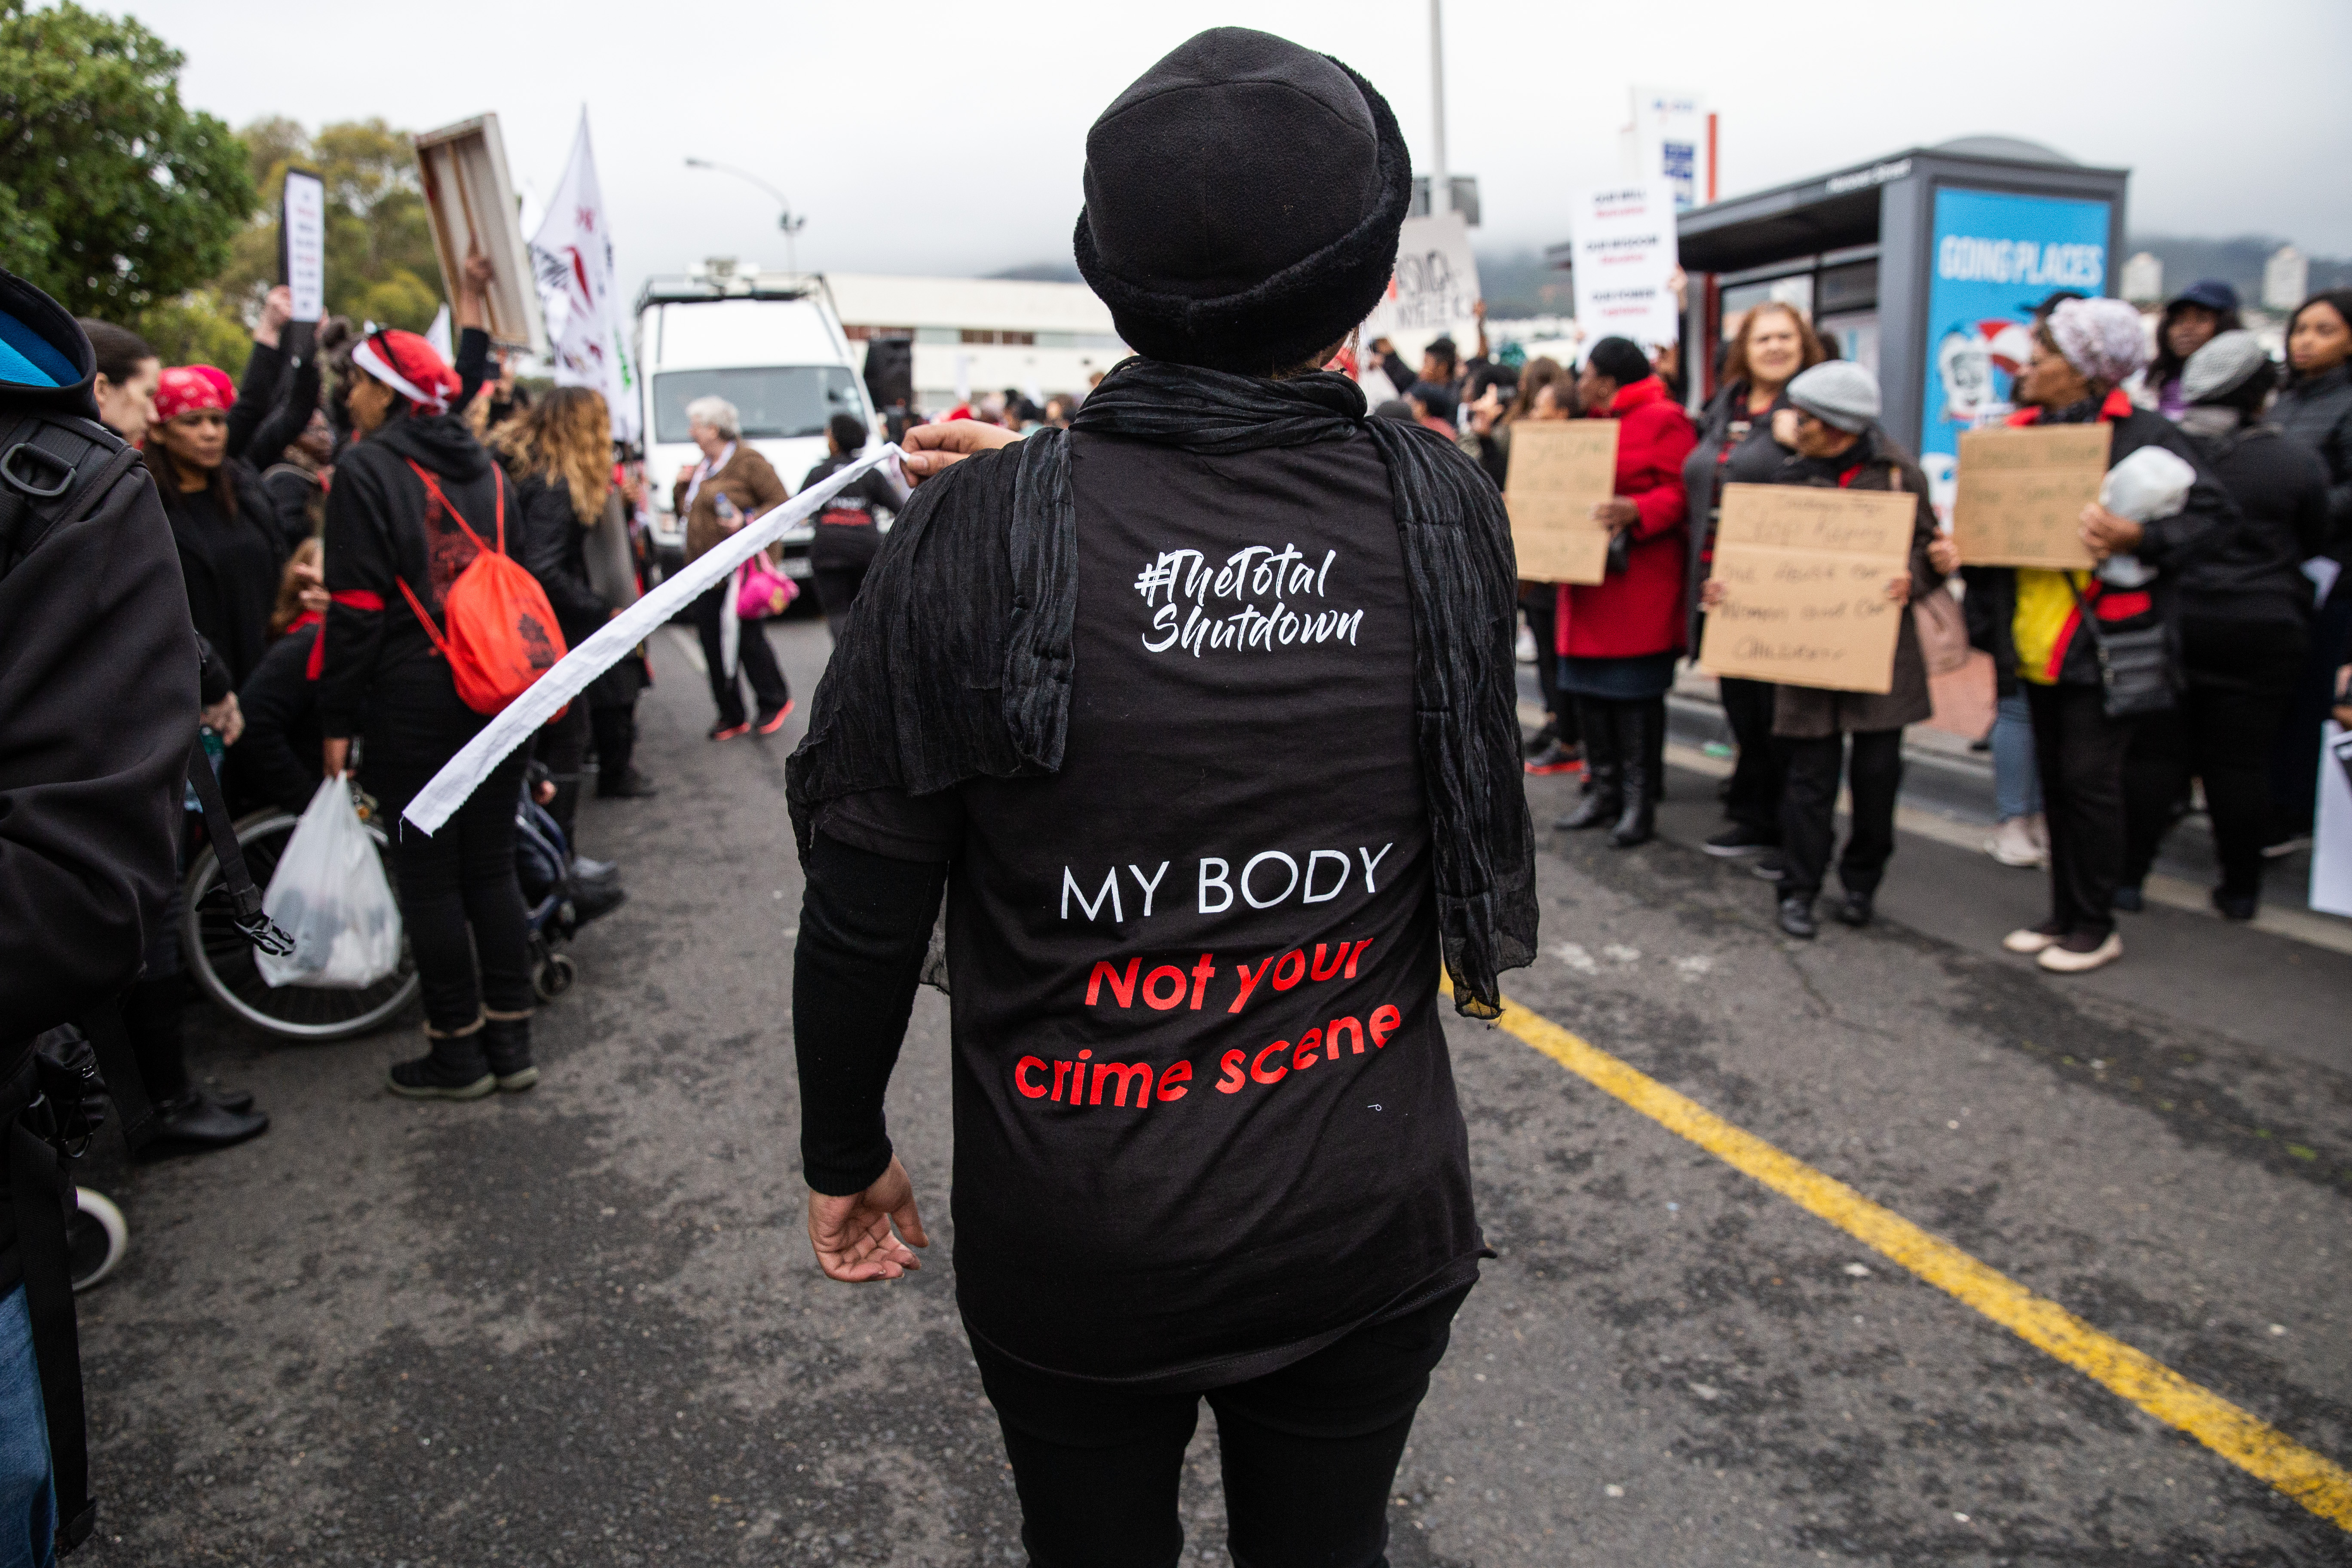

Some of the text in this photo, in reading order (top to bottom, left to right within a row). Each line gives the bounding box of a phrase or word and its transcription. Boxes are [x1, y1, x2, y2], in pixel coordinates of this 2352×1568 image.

[1939, 234, 2103, 287] GOING PLACES
[1134, 543, 1336, 607] #TheTotal
[1142, 602, 1364, 658] Shutdown
[1061, 842, 1393, 922] MY BODY
[1085, 938, 1374, 1014] Not your
[1015, 1004, 1401, 1109] crime scene
